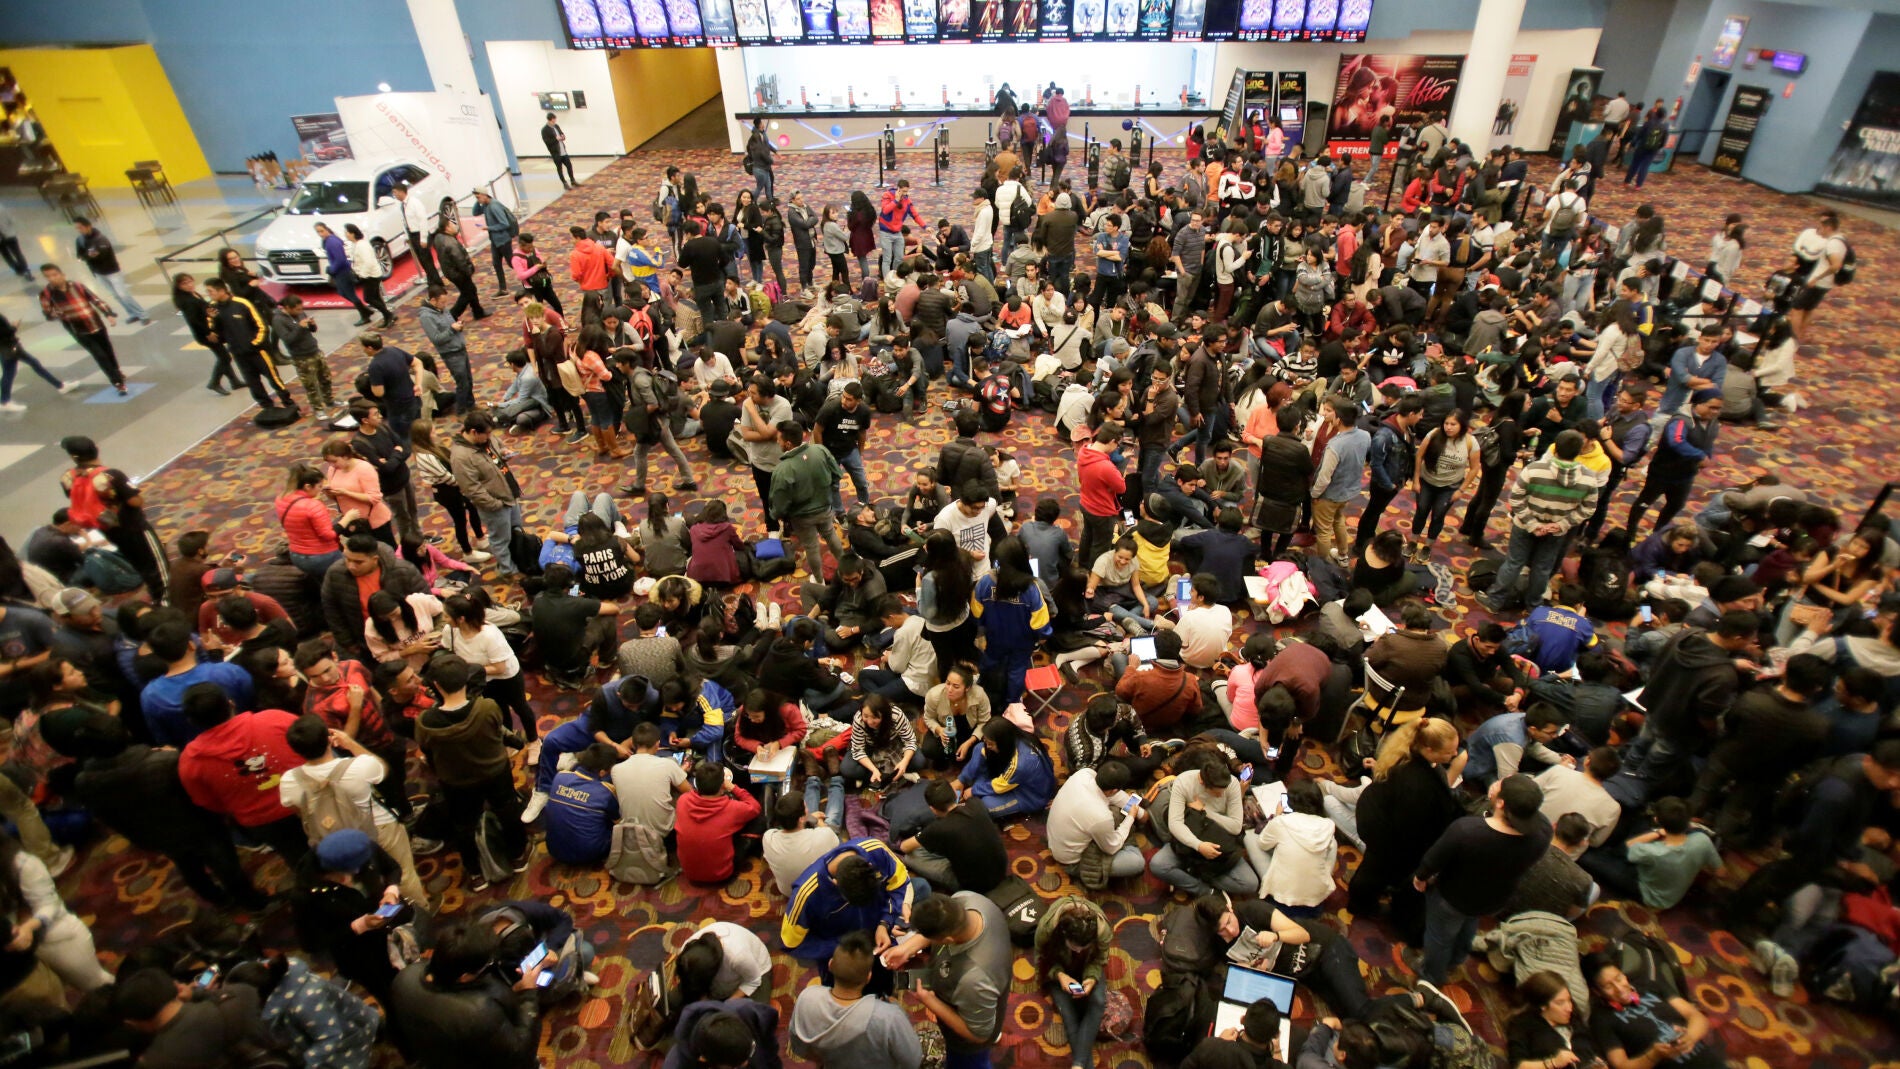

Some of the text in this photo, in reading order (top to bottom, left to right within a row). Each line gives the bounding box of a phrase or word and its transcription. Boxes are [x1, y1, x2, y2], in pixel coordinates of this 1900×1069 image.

[1402, 75, 1457, 107] After
[376, 102, 453, 183] Bienvenidos
[1336, 146, 1370, 155] ESTREN
[583, 548, 614, 564] PARIS
[585, 559, 618, 574] MILAN
[602, 565, 628, 582] YORK
[1546, 610, 1578, 630] EMI
[555, 784, 590, 803] EMI
[1008, 898, 1035, 918] CONVERSE
